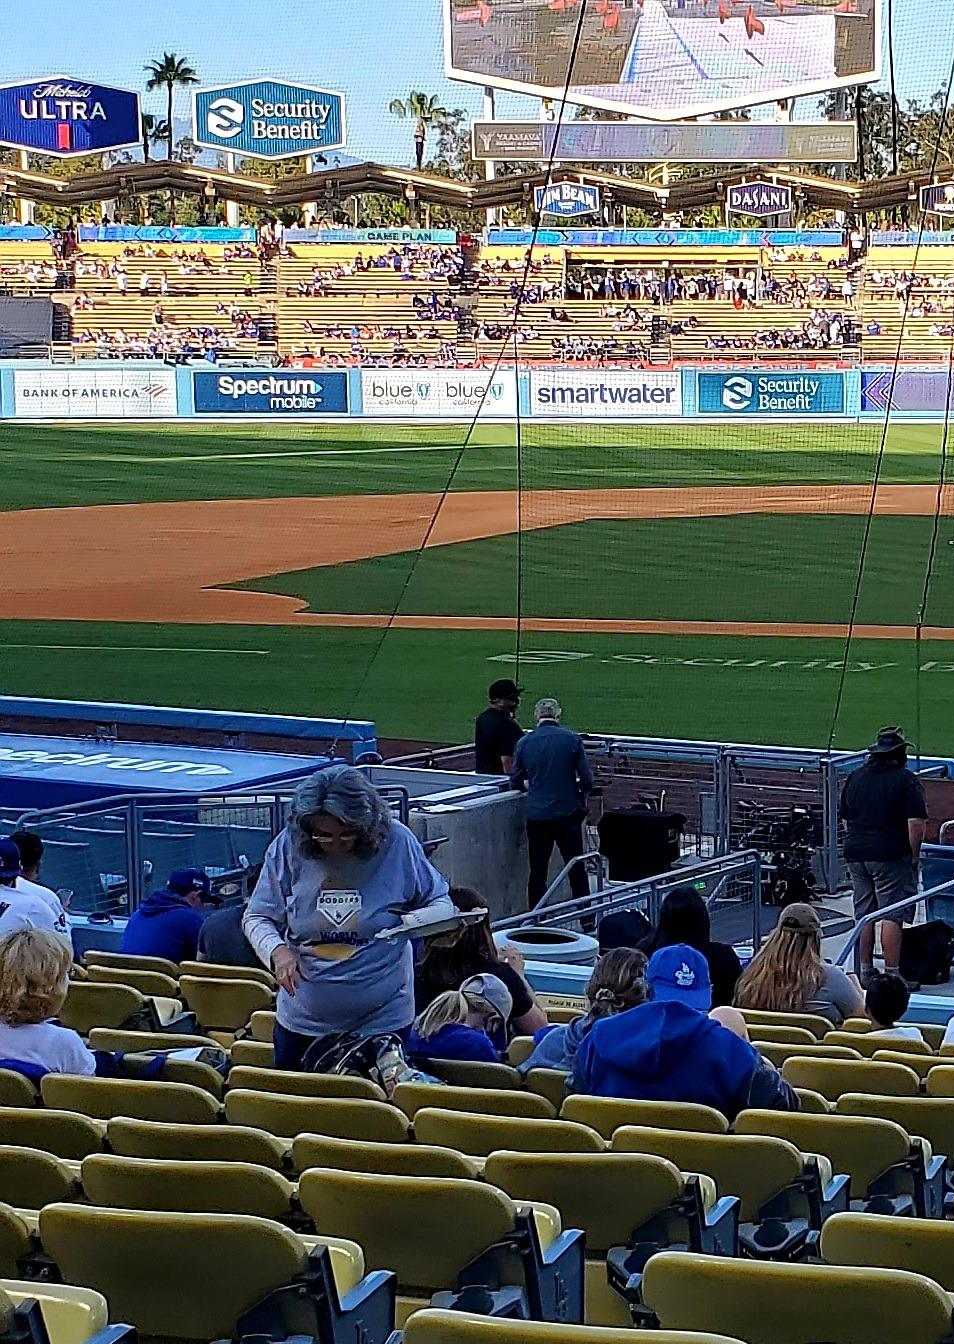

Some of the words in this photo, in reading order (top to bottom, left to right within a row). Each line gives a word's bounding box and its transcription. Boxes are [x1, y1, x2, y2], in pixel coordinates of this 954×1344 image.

[19, 99, 108, 121] ULTRA
[251, 99, 331, 124] Security
[252, 120, 323, 140] Benefit
[732, 191, 788, 208] DASANI
[367, 233, 399, 241] GAME
[402, 233, 432, 241] PLAN
[22, 389, 60, 398] BANK
[62, 389, 79, 398] OF
[81, 389, 140, 398] AMERICA
[219, 376, 315, 402] Spectrum
[372, 381, 413, 398] blue
[445, 381, 487, 398] blue
[537, 384, 676, 404] smartwater
[758, 377, 820, 396] Security
[270, 396, 315, 409] mobile
[758, 395, 812, 410] Benefit
[599, 654, 899, 672] Security
